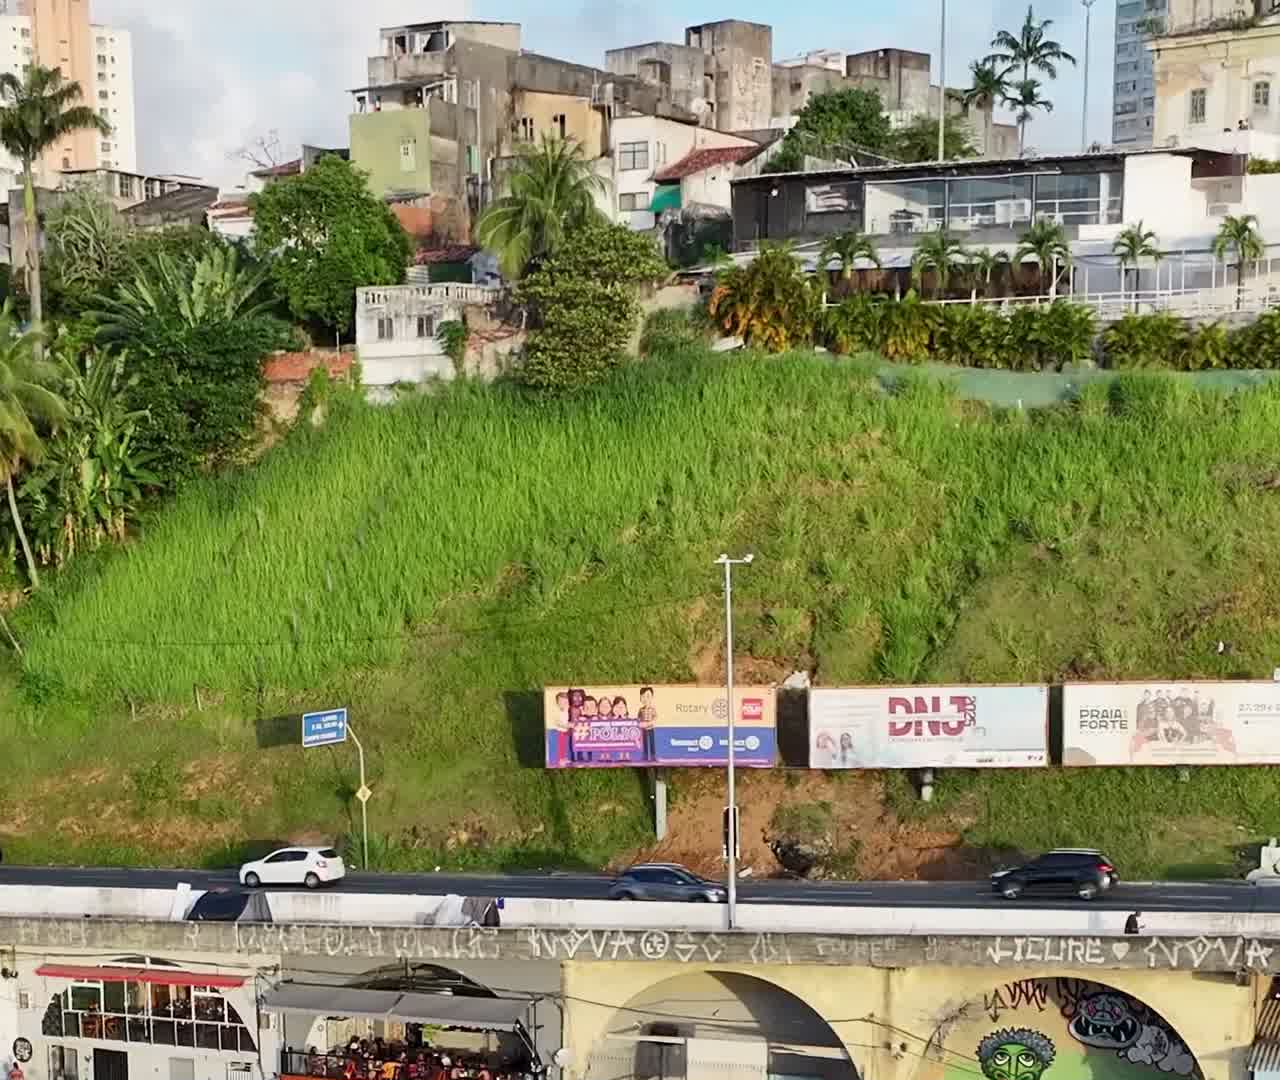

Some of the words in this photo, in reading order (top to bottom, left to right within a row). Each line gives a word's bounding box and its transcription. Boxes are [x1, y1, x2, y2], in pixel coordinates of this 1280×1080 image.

[675, 703, 708, 713] Rotary
[1079, 708, 1122, 719] PRAIA
[888, 696, 968, 737] DNJ
[1079, 719, 1128, 730] FORTE
